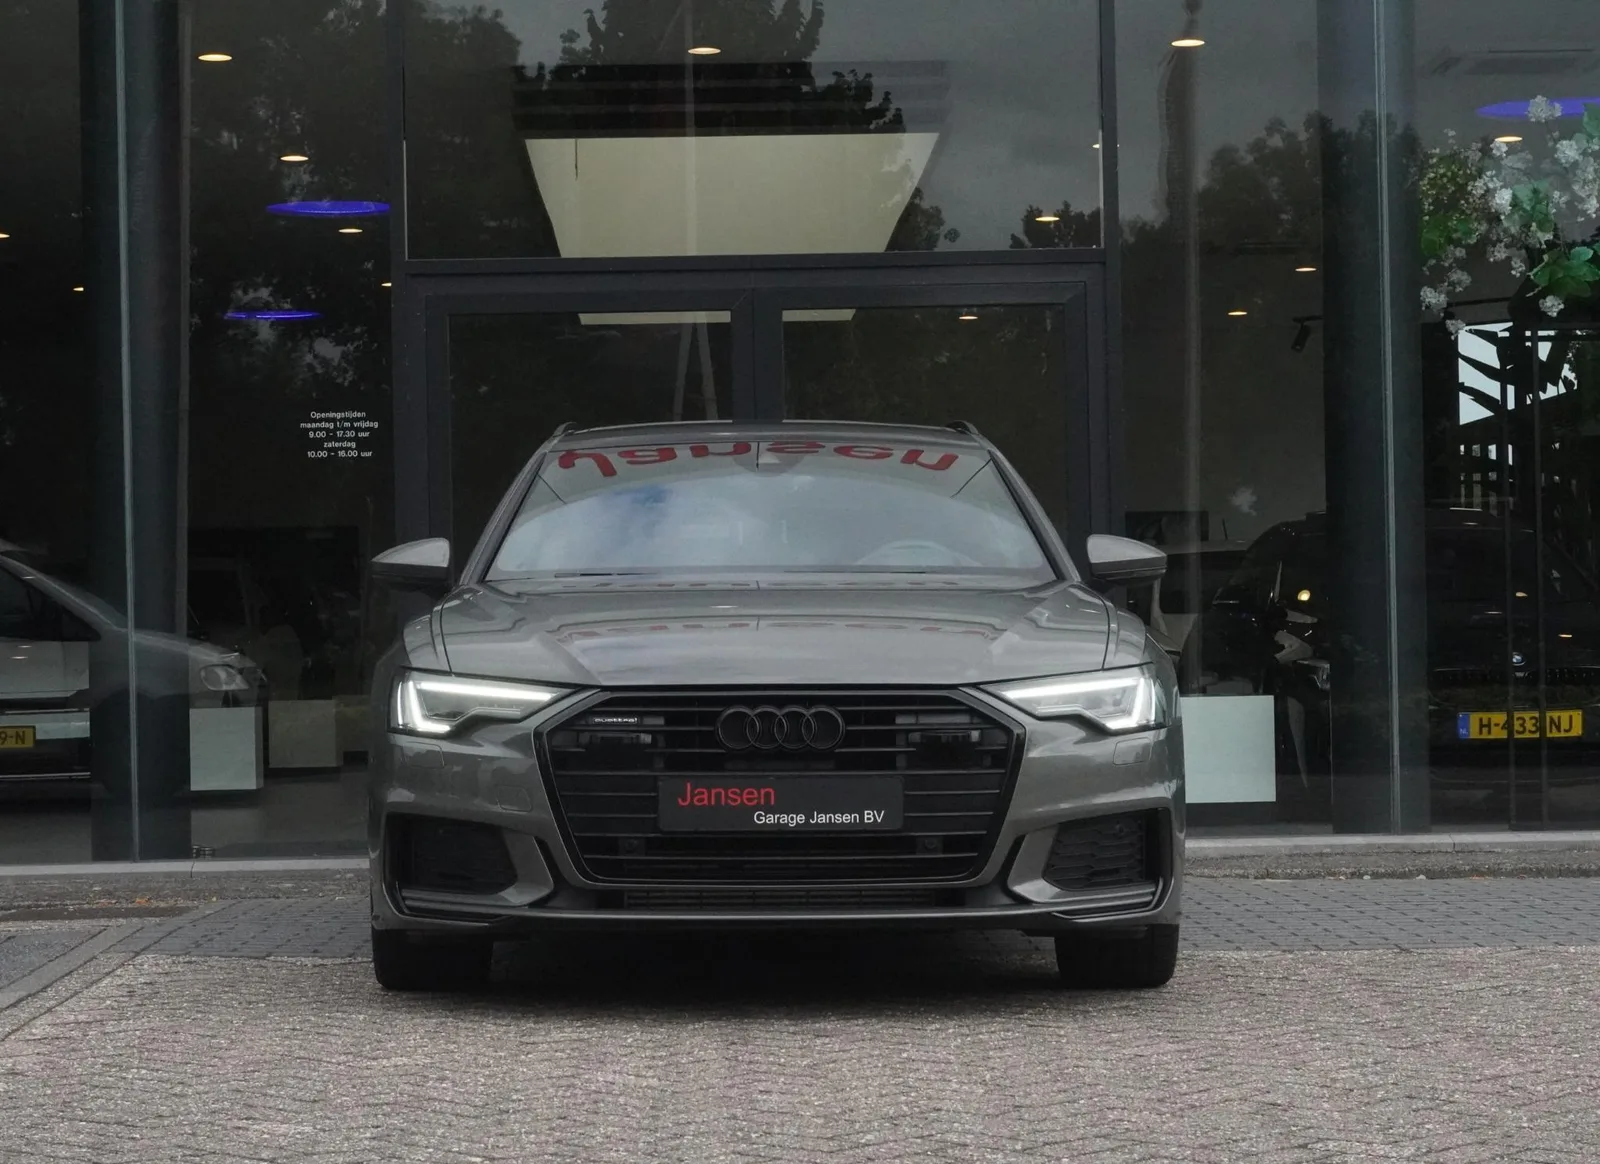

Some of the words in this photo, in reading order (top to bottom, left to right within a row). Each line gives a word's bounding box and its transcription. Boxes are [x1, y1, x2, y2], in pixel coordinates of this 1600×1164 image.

[310, 411, 366, 419] Openingstijden
[300, 421, 334, 429] maandag
[336, 430, 356, 438] 17.30
[677, 782, 776, 807] Jansen
[753, 811, 806, 827] Garage
[809, 811, 860, 824] Jansen
[863, 810, 885, 823] BV
